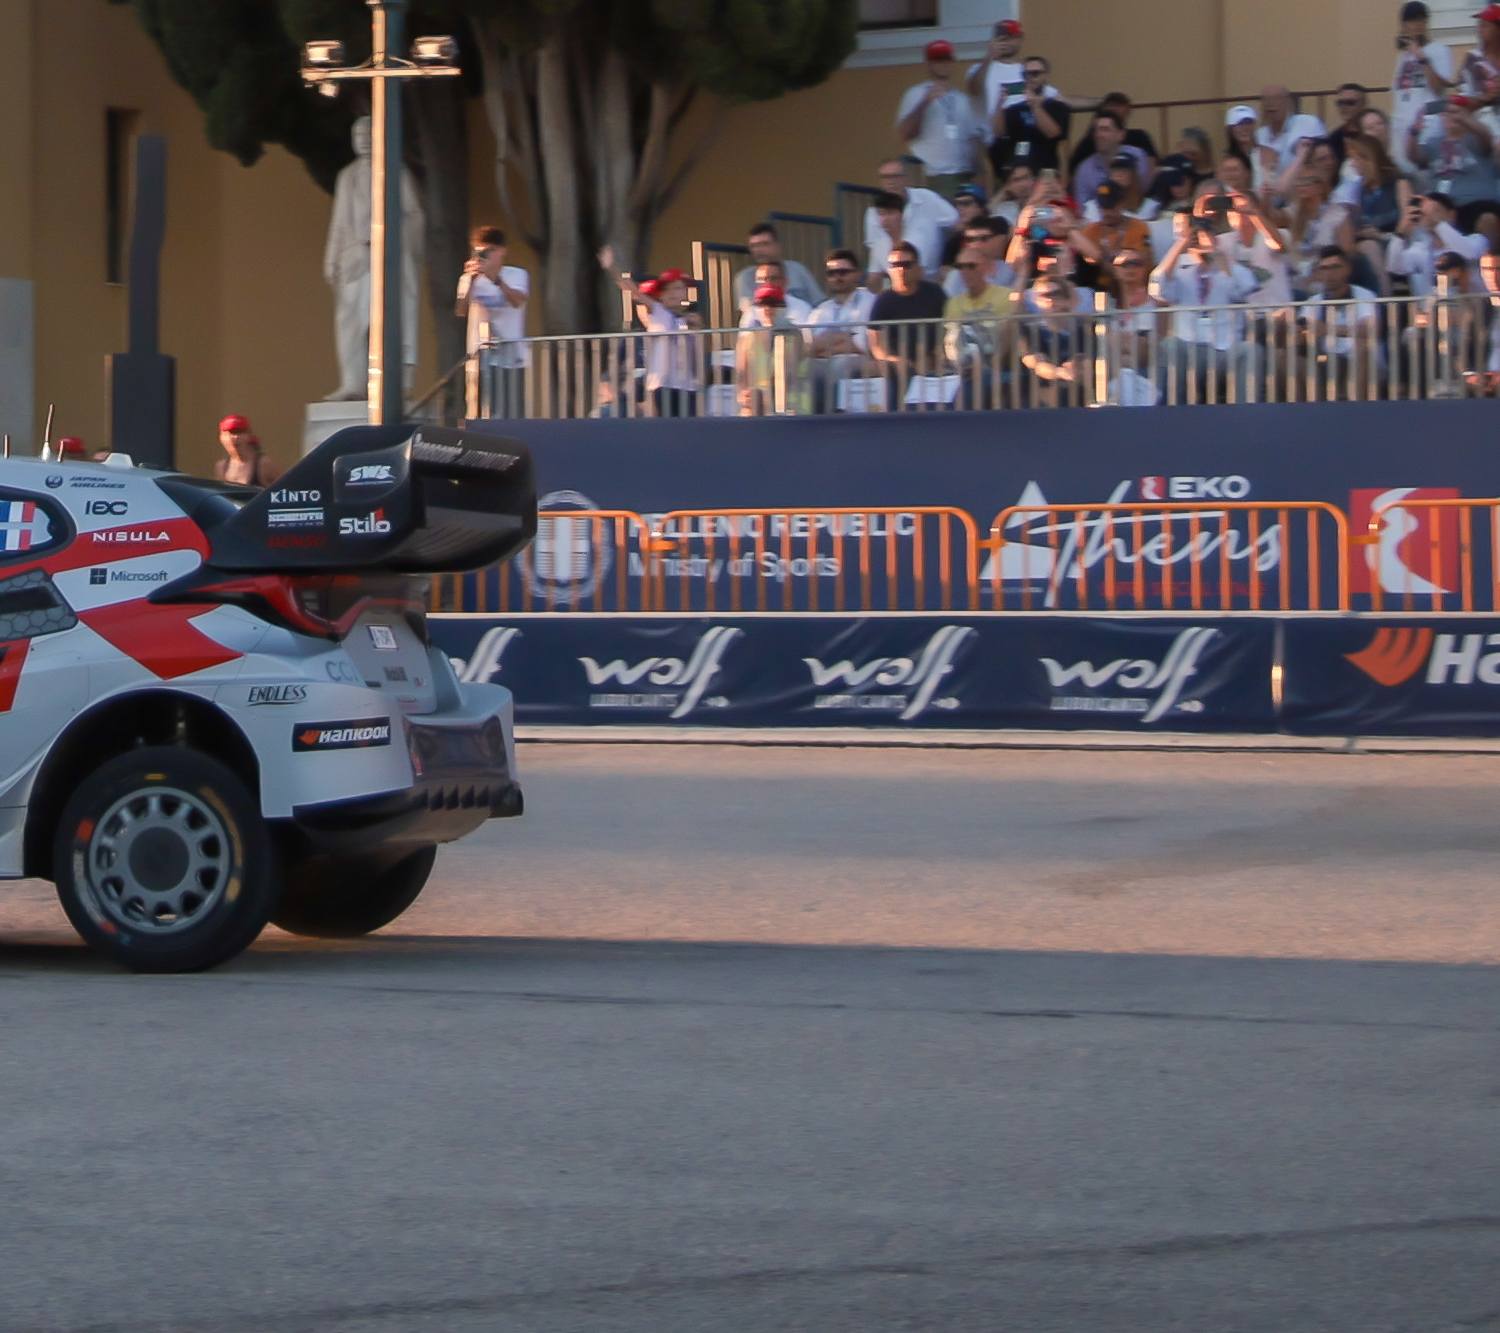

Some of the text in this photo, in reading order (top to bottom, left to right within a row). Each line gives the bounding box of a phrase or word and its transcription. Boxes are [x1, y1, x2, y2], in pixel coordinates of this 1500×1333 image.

[1168, 475, 1251, 499] EKO
[339, 507, 391, 534] Stilo
[92, 531, 170, 543] NISULA
[110, 570, 169, 582] Microsoft
[577, 625, 744, 719] wolf
[802, 625, 977, 720] wolf
[1038, 626, 1221, 723] wolf
[247, 684, 308, 703] ENDLESS
